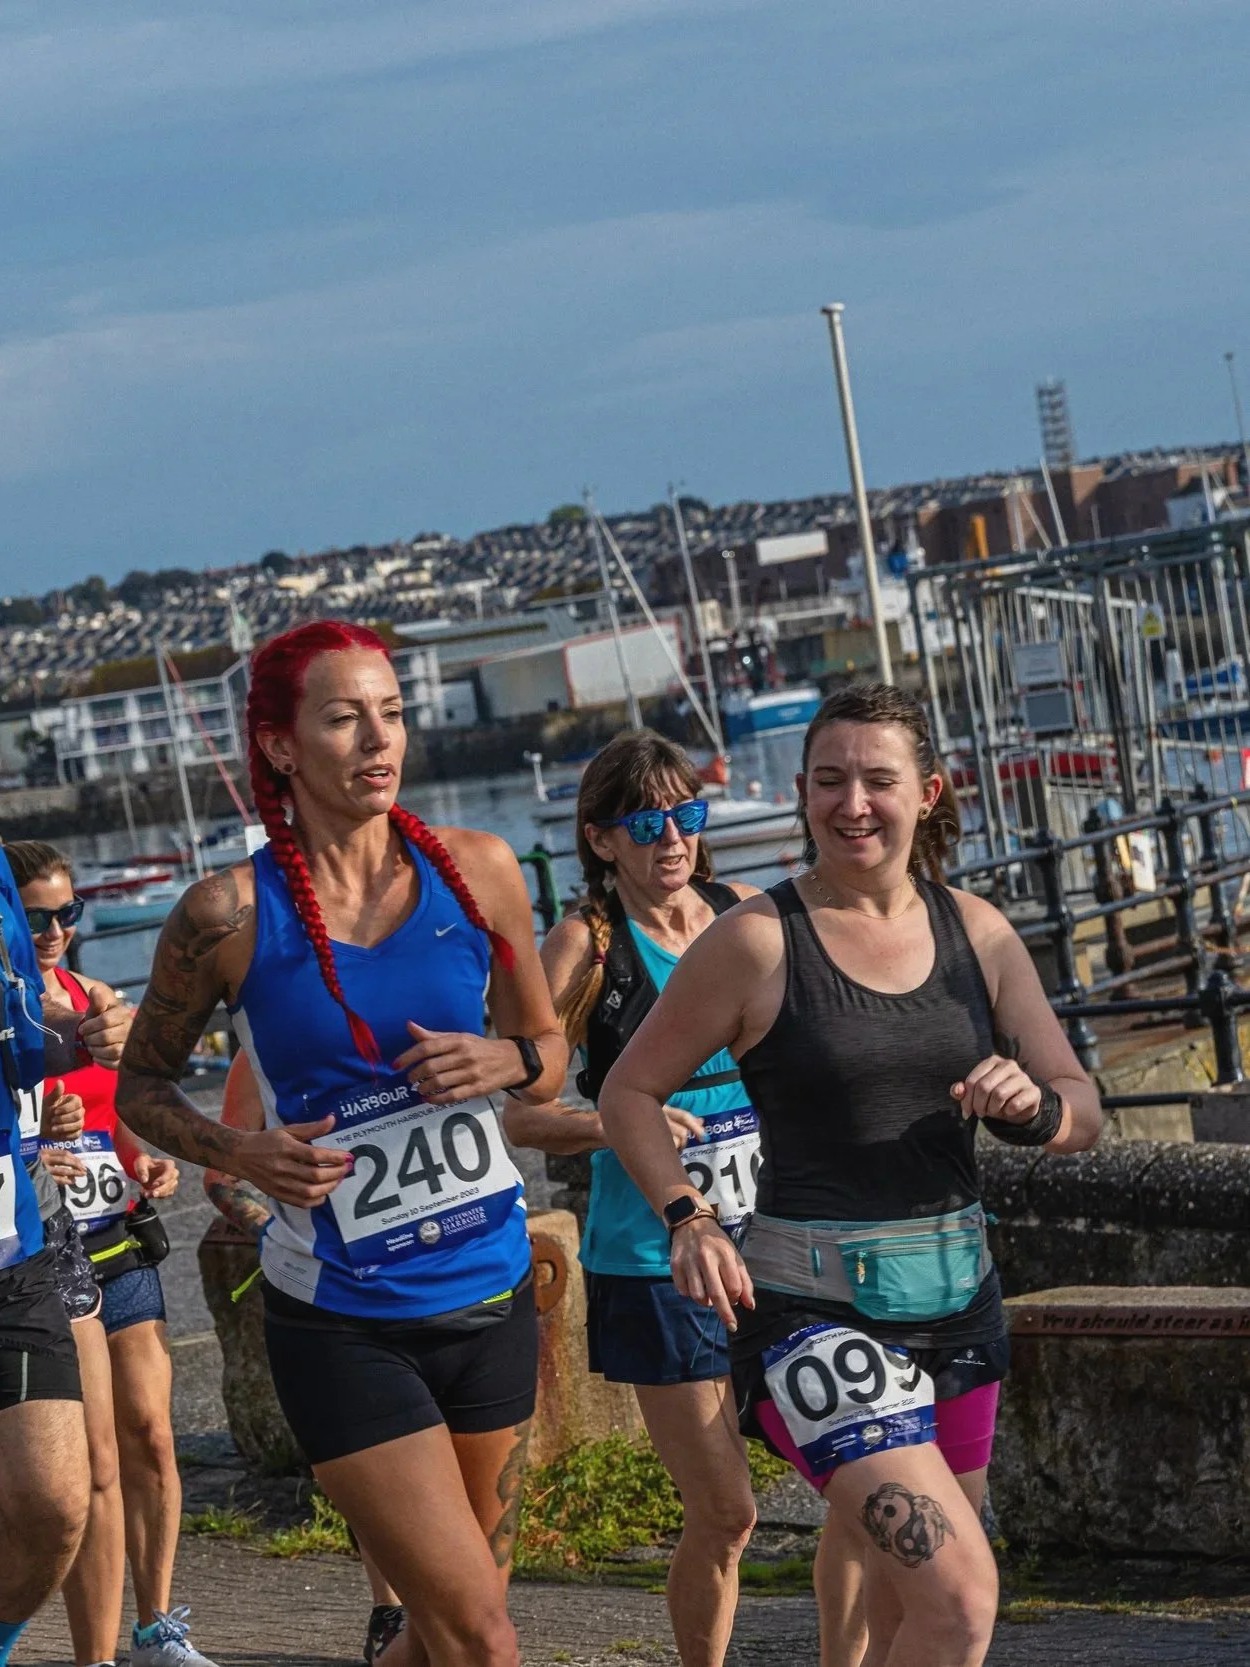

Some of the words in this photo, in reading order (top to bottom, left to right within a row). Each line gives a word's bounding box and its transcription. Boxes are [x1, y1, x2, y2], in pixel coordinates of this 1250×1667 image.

[340, 1086, 410, 1118] HARBOUR
[353, 1120, 397, 1138] PLYMOUTH
[398, 1107, 436, 1125] HARBOUR
[344, 1112, 491, 1220] 240
[59, 1163, 124, 1208] 96
[382, 1212, 409, 1225] Sunday
[419, 1195, 459, 1212] September
[460, 1187, 480, 1198] 2023
[1080, 1313, 1150, 1329] should
[1151, 1314, 1207, 1330] steer
[1209, 1316, 1234, 1330] as
